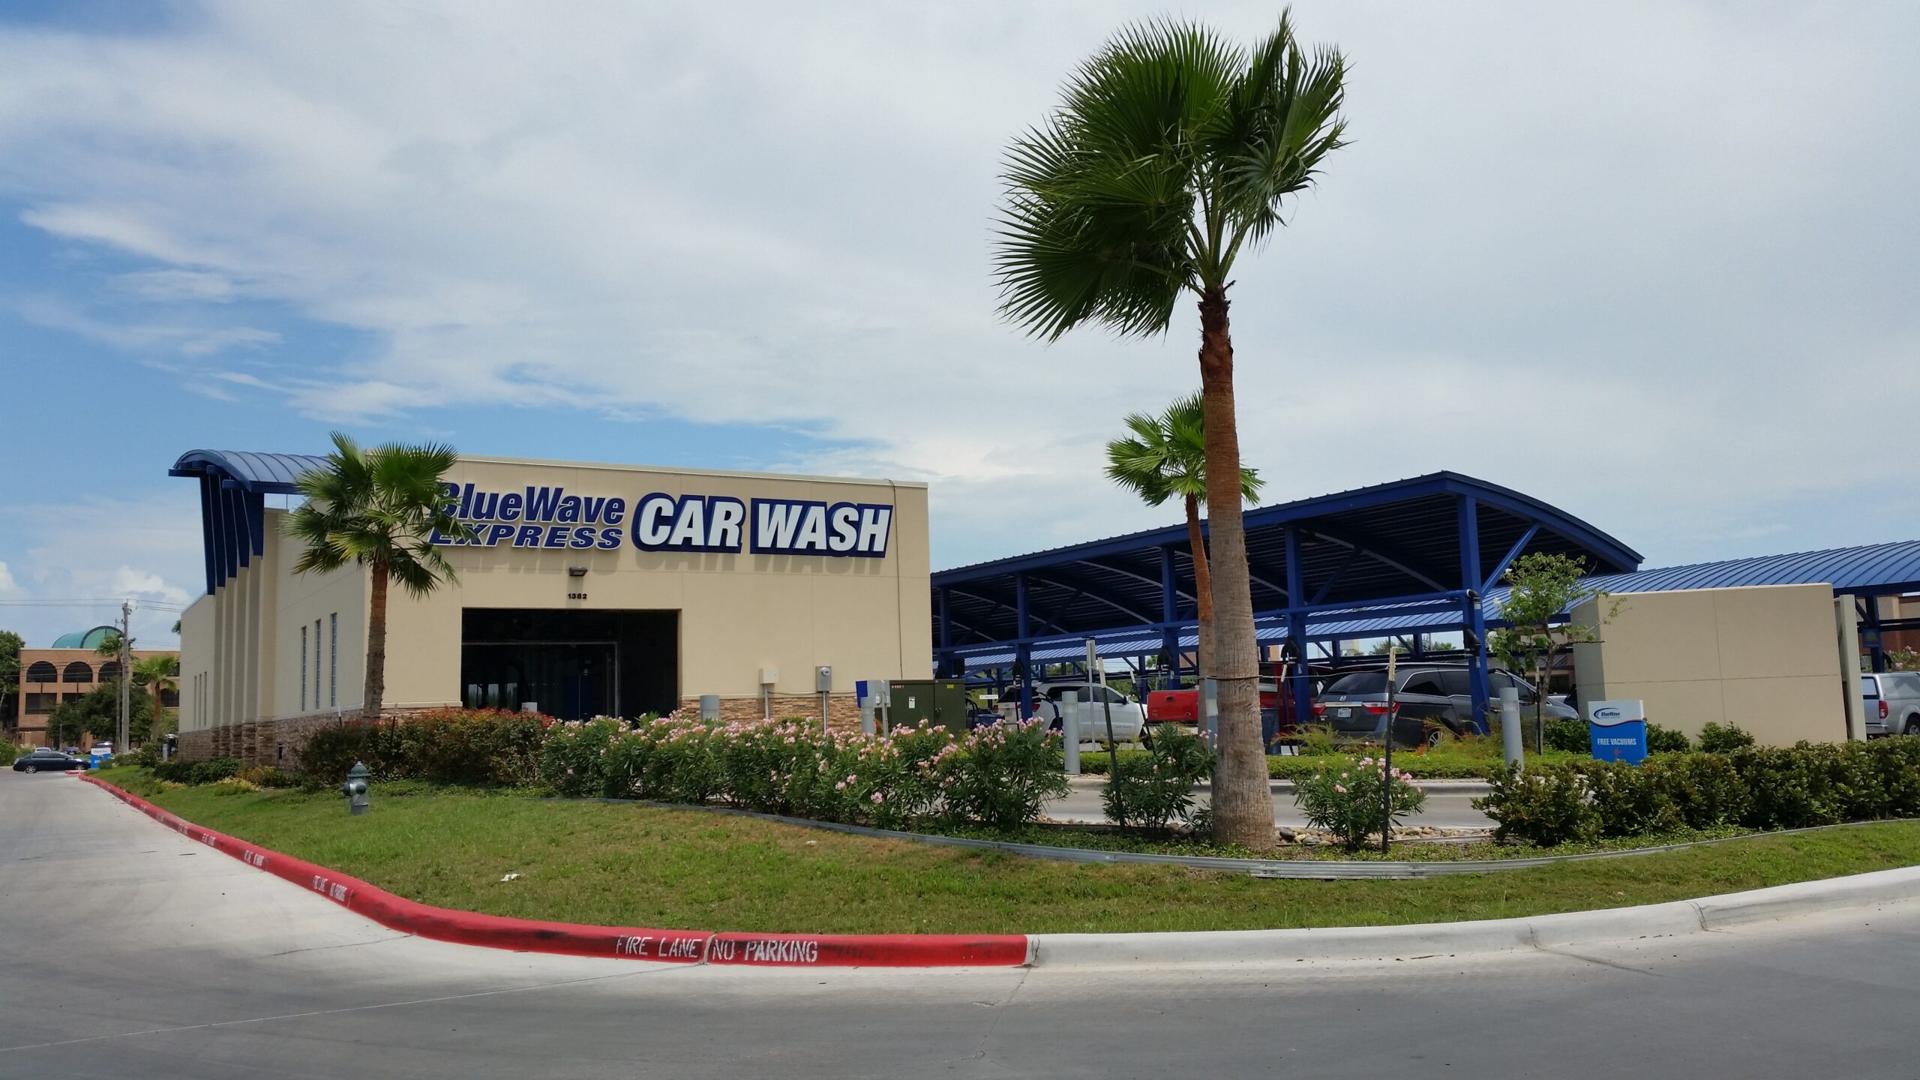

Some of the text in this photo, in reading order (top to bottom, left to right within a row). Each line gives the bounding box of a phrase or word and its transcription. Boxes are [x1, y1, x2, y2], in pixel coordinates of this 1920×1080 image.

[432, 482, 626, 525] BlueWave
[636, 496, 892, 553] CAR WASH
[616, 936, 818, 963] FIRE LANE NO PARKING
